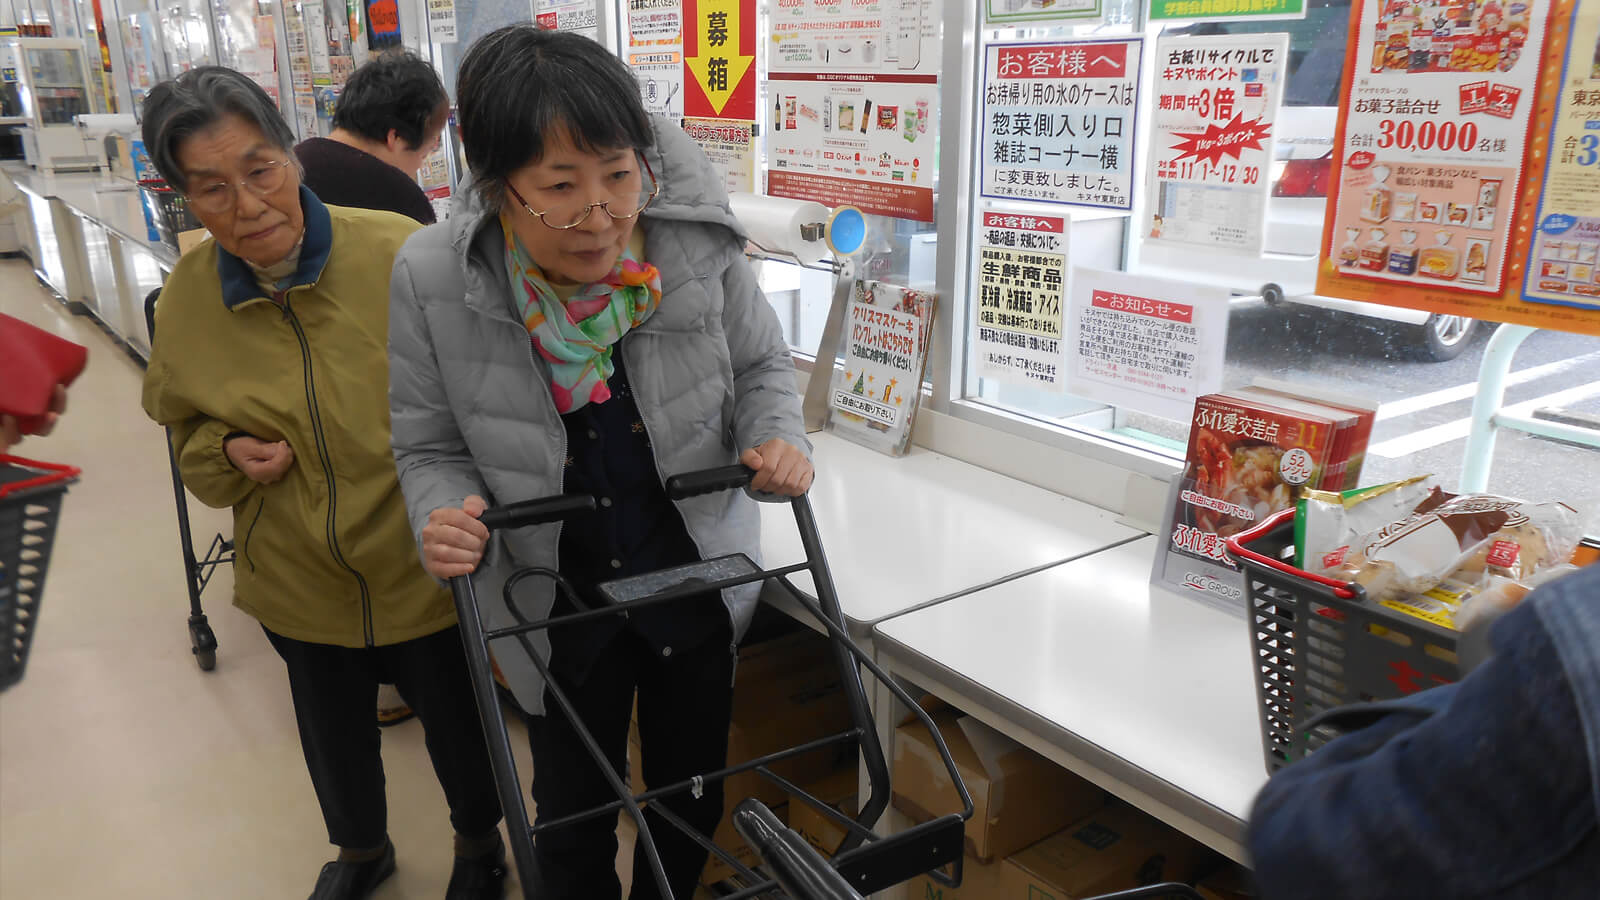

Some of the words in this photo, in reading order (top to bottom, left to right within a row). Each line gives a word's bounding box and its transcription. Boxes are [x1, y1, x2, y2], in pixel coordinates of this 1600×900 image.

[707, 0, 728, 91] 募箱
[1169, 48, 1274, 64] 古紙リサイクルで
[999, 50, 1121, 76] お客様へ
[1162, 67, 1238, 81] キヌヤポイント
[986, 82, 1134, 106] お持帰り用の氷のケースは
[1159, 87, 1235, 121] 期間中3倍
[1354, 98, 1441, 115] お菓子詰合せ
[992, 111, 1122, 139] 惣菜側入り口
[1351, 133, 1373, 147] 合計
[1377, 119, 1478, 152] 30,000
[1479, 138, 1506, 153] 名様
[993, 139, 1118, 170] 雑誌コーナー横
[994, 169, 1120, 193] に変更致しました。
[1077, 193, 1126, 205] キヌヤ東町店
[988, 215, 1053, 229] お客様へ
[982, 262, 1062, 284] 生鮮商品
[1095, 294, 1189, 317] ～お知らせ～
[853, 305, 913, 334] クリスマスケーキ
[1196, 407, 1281, 444] ふれ愛交差点
[1281, 464, 1311, 479] レシピ
[1289, 454, 1305, 468] 52
[1182, 490, 1254, 520] ご自由にお取り下さい
[1173, 525, 1237, 566] ふれ愛交
[1185, 573, 1206, 586] CGC
[1207, 581, 1241, 599] GROUP
